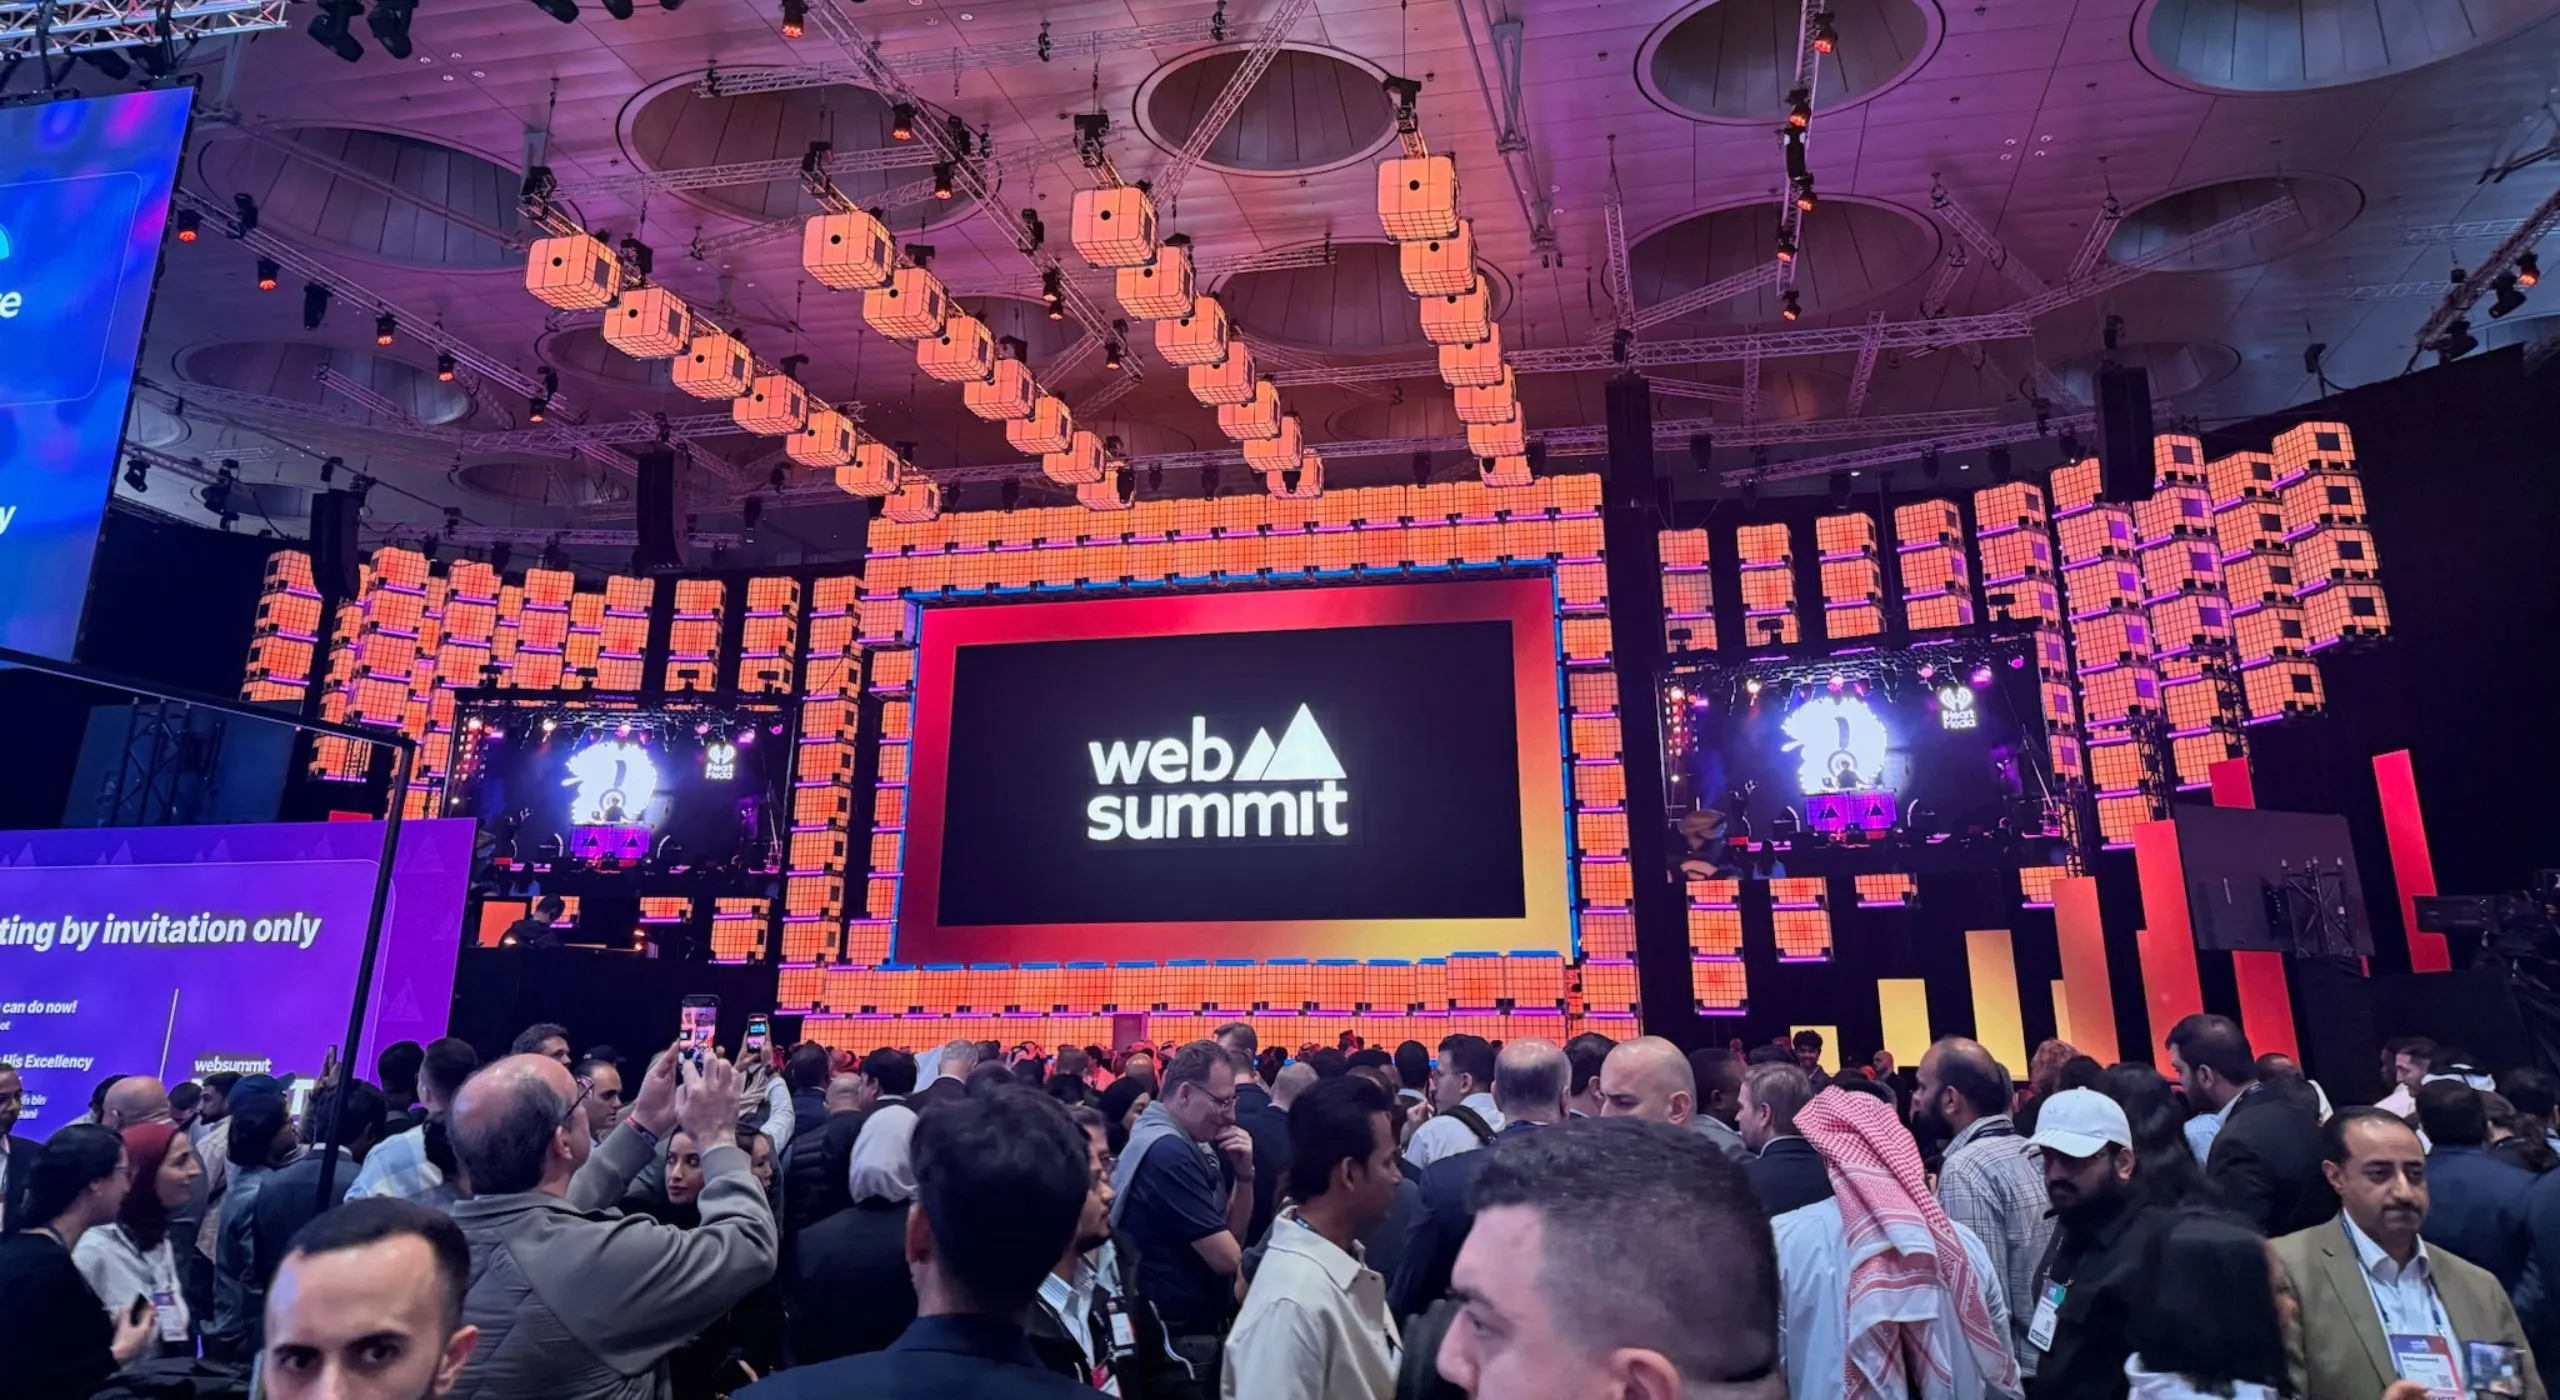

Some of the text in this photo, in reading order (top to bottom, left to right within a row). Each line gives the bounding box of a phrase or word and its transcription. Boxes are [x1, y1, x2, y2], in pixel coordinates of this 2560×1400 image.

[1088, 716, 1234, 785] web
[1087, 780, 1348, 841] summit
[59, 915, 100, 951] by
[102, 912, 247, 944] invitation
[252, 912, 322, 949] only
[2, 1000, 78, 1014] can do now!
[3, 1054, 94, 1072] His Excellency
